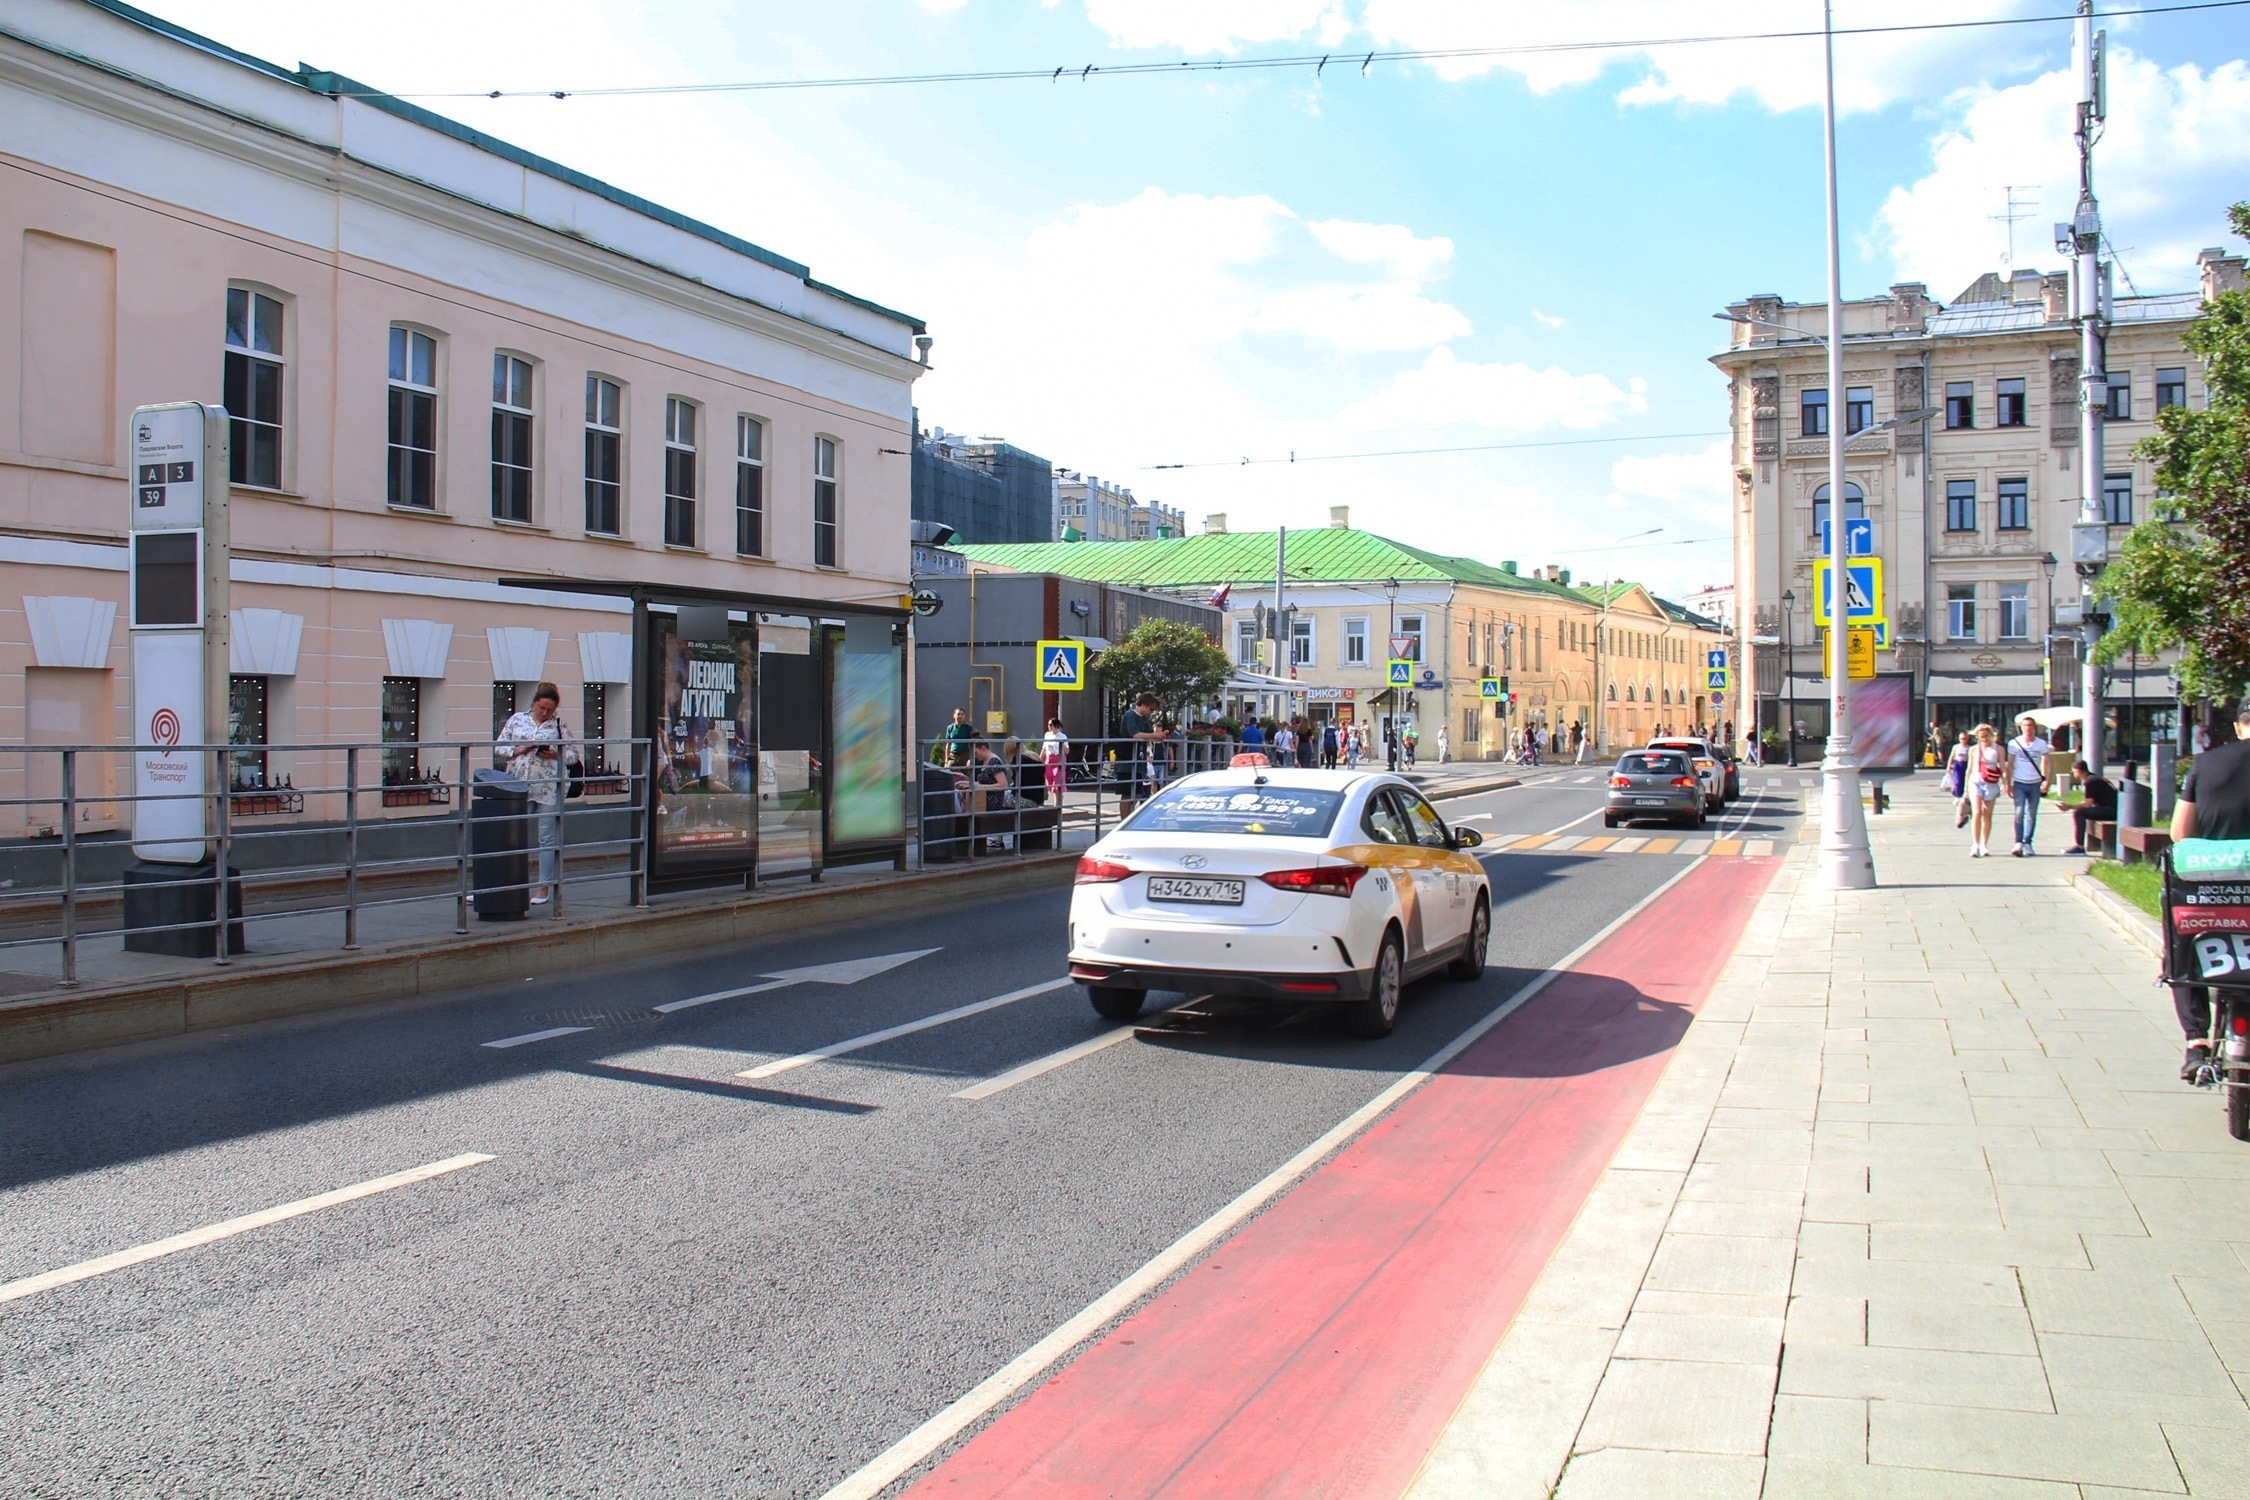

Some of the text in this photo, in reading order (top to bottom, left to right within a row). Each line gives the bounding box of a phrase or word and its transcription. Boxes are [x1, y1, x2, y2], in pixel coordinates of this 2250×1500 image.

[177, 466, 185, 479] 3
[145, 490, 160, 504] 39
[687, 660, 735, 694] ЛЕОНИД
[1307, 688, 1342, 699] ДИКСИ
[680, 689, 726, 718] АГУТИН
[145, 761, 188, 771] Московский
[149, 771, 187, 783] Транспорт
[1179, 794, 1230, 804] Яндекс
[1261, 796, 1301, 806] Такси
[1152, 802, 1176, 810] +7
[1176, 802, 1226, 811] (495)
[1227, 803, 1264, 812] 999
[1265, 805, 1290, 814] 99
[1291, 807, 1317, 815] 99
[1215, 882, 1239, 895] 716
[2186, 895, 2198, 904] В
[2199, 895, 2242, 904] ЛЮБУЮ
[2180, 918, 2249, 929] ДОСТАВКА
